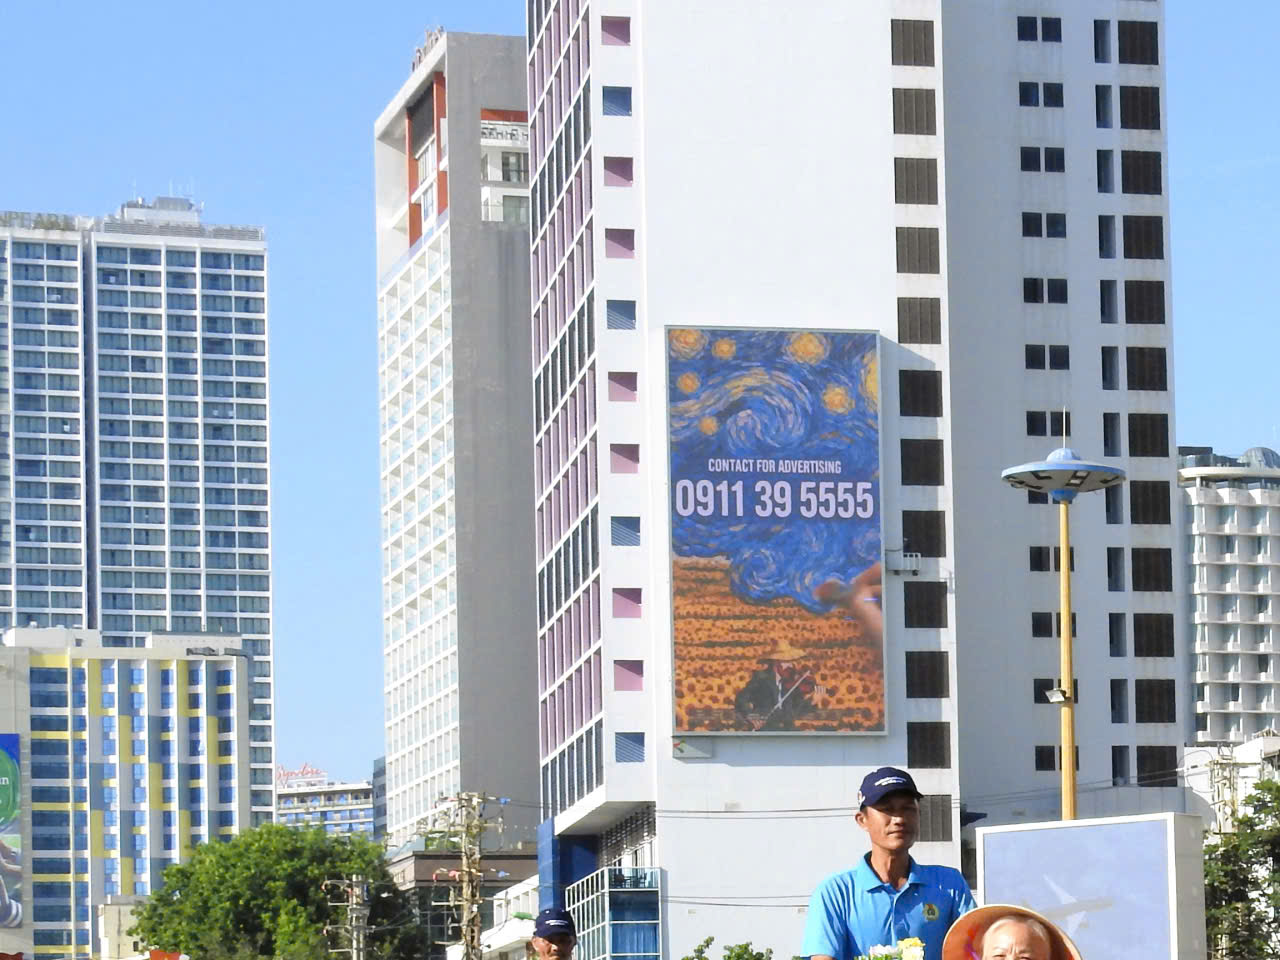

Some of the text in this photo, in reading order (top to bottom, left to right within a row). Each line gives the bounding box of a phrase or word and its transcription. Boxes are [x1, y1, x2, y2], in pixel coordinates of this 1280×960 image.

[708, 457, 842, 475] CONTACT FOR ADVERTISING
[675, 478, 874, 519] 0911 39 5555
